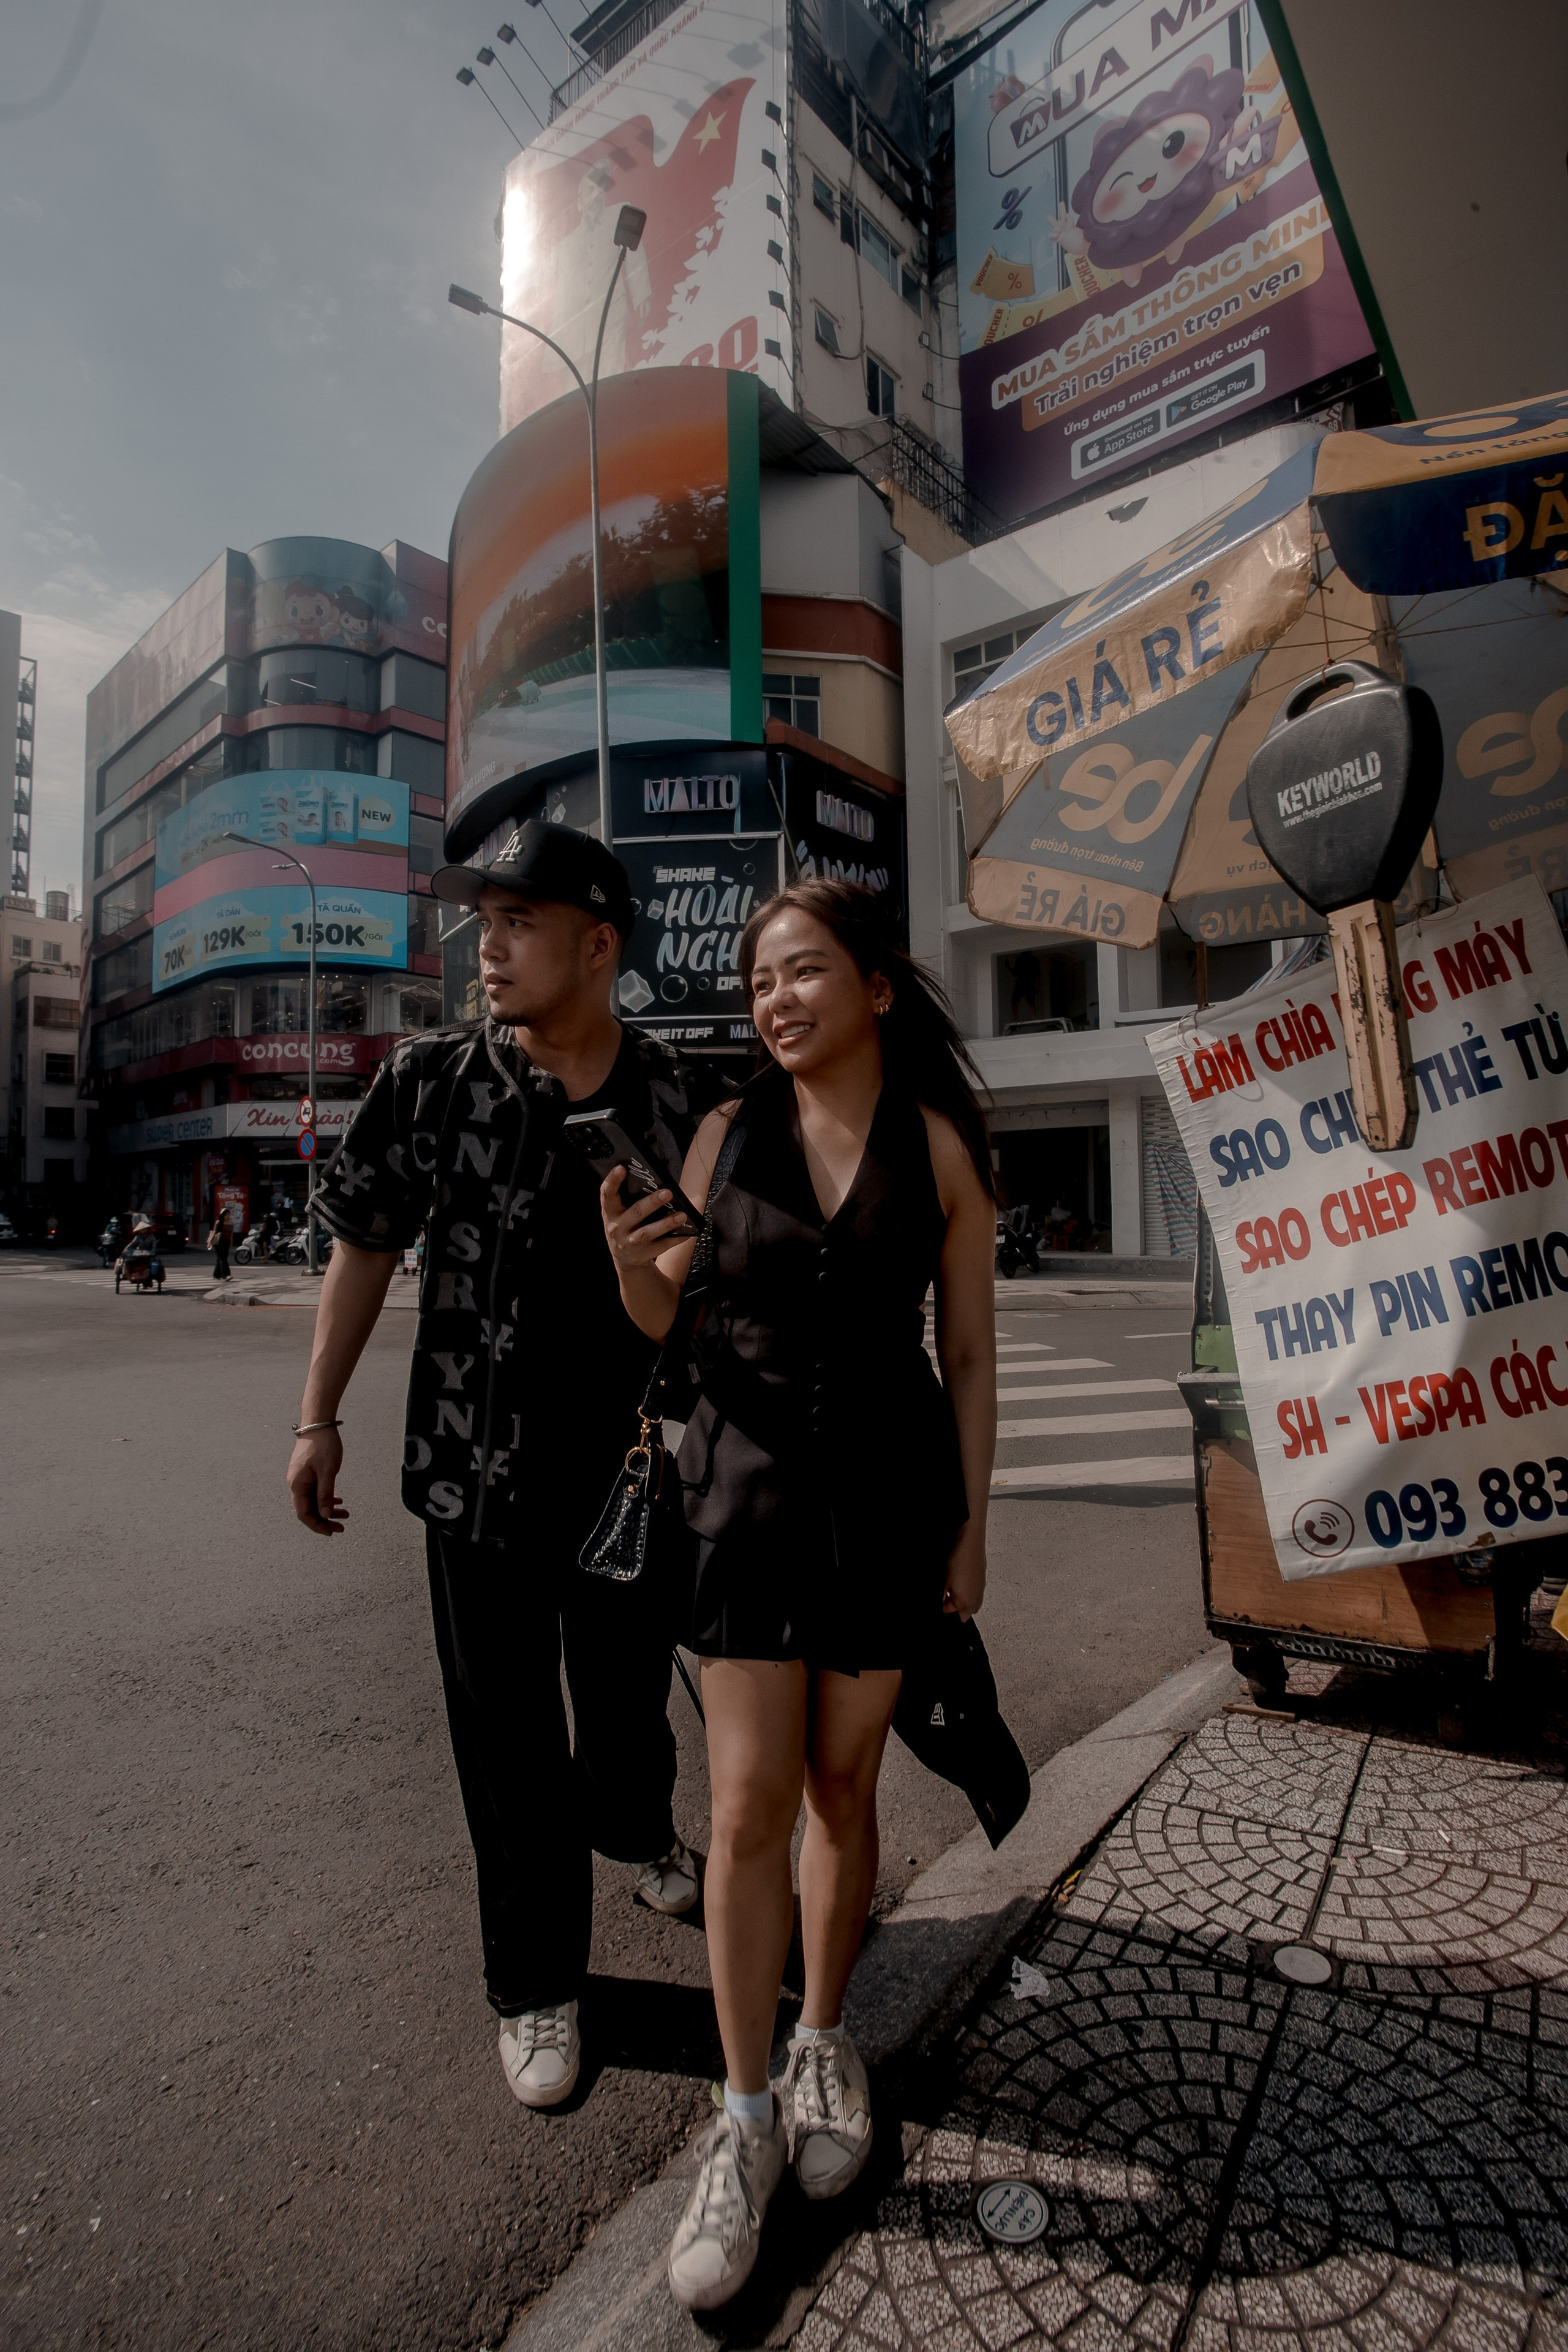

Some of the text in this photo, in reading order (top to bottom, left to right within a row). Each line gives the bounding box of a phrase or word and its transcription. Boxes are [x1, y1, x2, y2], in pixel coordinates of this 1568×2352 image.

[1150, 0, 1219, 51] M
[1074, 255, 1101, 298] OUCHER
[983, 308, 1004, 347] OUCHER
[998, 357, 1057, 402] MUA
[1065, 319, 1126, 365] SẮM
[1133, 252, 1243, 328] THÔNG
[1035, 262, 1301, 415] Trải nghiệm trọn vẹn
[1064, 325, 1270, 435] Ứng dụng mua sắm trực tuyến
[1191, 377, 1248, 411] Google Play
[1104, 417, 1153, 443] Download on the
[1104, 424, 1154, 454] App Store
[1027, 579, 1224, 747] GIÁ RẺ
[644, 775, 739, 813] MALTO
[1277, 751, 1382, 818] KEYWORLD
[361, 809, 391, 823] NEW
[655, 867, 716, 883] SHAKE
[665, 876, 754, 928] HOÀI
[203, 925, 246, 954] 129K
[291, 922, 366, 947] 150K
[656, 930, 744, 973] NGH
[730, 1024, 759, 1039] MAL
[1175, 1032, 1257, 1104] LÀM
[1254, 998, 1336, 1073] CHÌA
[1433, 918, 1533, 1001] MÁY
[686, 1027, 714, 1039] OFF
[247, 1103, 354, 1127] Xin ào!
[1209, 1118, 1291, 1188] SAO
[1300, 1088, 1365, 1155] CH
[1414, 1021, 1504, 1114] THẺ
[1235, 1207, 1311, 1275] SAO
[1320, 1166, 1416, 1248] CHÉP
[1254, 1287, 1356, 1361] THAY
[1368, 1265, 1450, 1337] PIN
[1276, 1395, 1329, 1460] SH
[1357, 1367, 1487, 1445] VESPA
[1490, 1338, 1568, 1419] CÁC
[1364, 1477, 1467, 1549] 093
